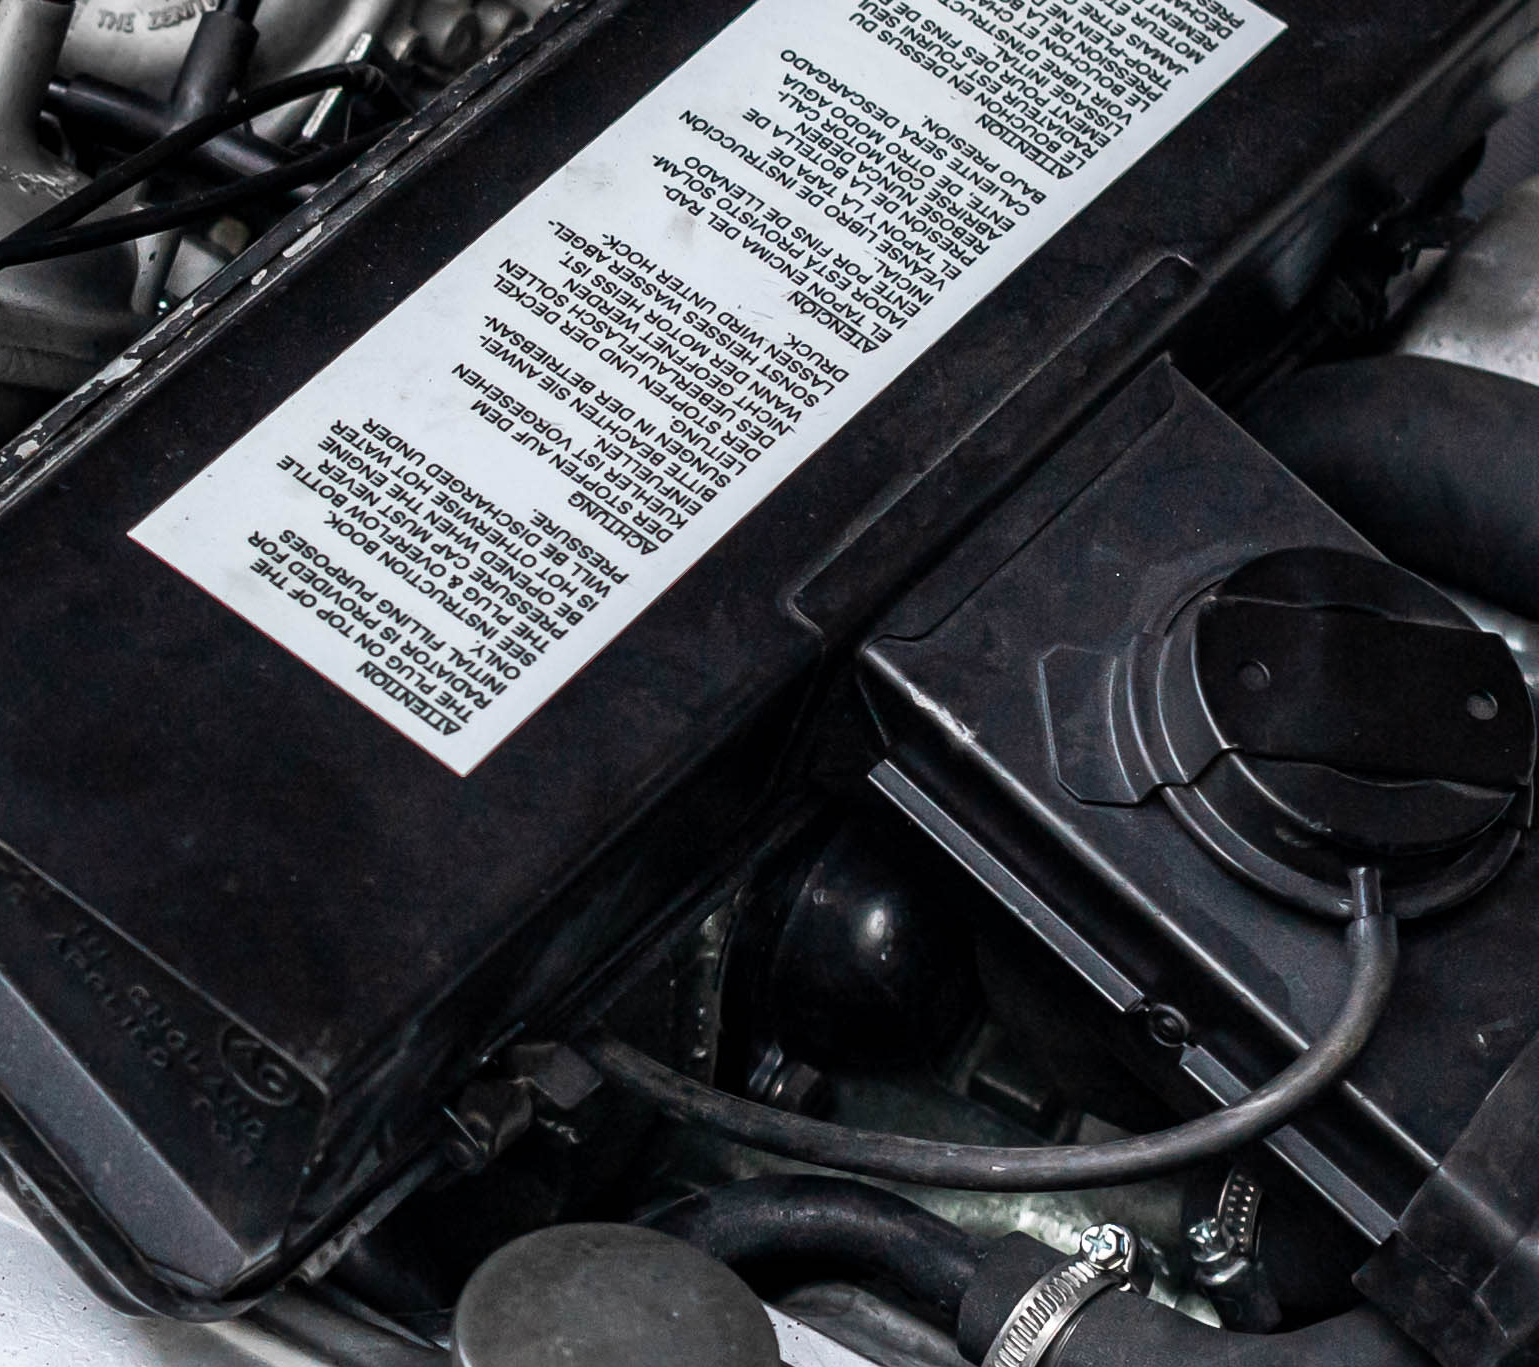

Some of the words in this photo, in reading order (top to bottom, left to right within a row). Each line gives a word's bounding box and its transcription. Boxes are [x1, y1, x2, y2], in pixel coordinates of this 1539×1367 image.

[1045, 3, 1074, 25] NE
[993, 42, 1050, 88] INITIAL.
[1039, 58, 1092, 96] LIBRE
[1072, 20, 1172, 92] TROP-PLEIN
[1049, 84, 1124, 137] LISSAGE
[1090, 92, 1132, 126] VOIR
[678, 109, 798, 190] INSTRUCCIÓN
[793, 121, 857, 165] DEBEN
[974, 113, 1074, 180] ATTENTION
[652, 154, 716, 200] SOLAM-
[795, 185, 825, 208] DE
[857, 160, 919, 207] NUNCA
[716, 197, 806, 260] PROVISTO
[823, 204, 878, 244] LIBRO
[916, 202, 991, 256] REBOSE
[498, 258, 569, 308] SOLLEN
[802, 254, 853, 291] ESTÁ
[874, 256, 935, 306] INICIAL.
[875, 239, 946, 292] VEÁNSE
[562, 277, 640, 335] WERDEN
[786, 290, 880, 354] ATENCIÓN
[850, 286, 908, 330] IADOR
[479, 335, 543, 379] ANWEI-
[483, 315, 597, 395] BETRIEBSAN-
[567, 303, 737, 423] UEBERLAUFFLASCH
[638, 331, 735, 397] GEOFFNET
[451, 363, 573, 452] VORGESEHEN
[537, 375, 572, 401] SIE
[594, 389, 636, 422] DER
[568, 397, 667, 467] BEACHTEN
[632, 417, 657, 437] IN
[732, 395, 792, 437] NICHT
[736, 419, 776, 450] DES
[317, 435, 389, 488] ENGINE
[330, 419, 393, 468] WATER
[362, 417, 426, 467] UNDER
[571, 448, 606, 472] IST
[653, 432, 732, 488] SUNGEN
[669, 415, 748, 476] LEITUNG.
[275, 454, 349, 508] BOTTLE
[317, 458, 382, 507] NEVER
[390, 465, 434, 496] HOT
[593, 434, 704, 517] EINFUELLEN.
[603, 466, 689, 530] KUEHLER
[663, 462, 718, 503] BITTE
[385, 483, 424, 515] THE
[425, 463, 543, 548] DISCHARGED
[323, 510, 381, 556] BOOK.
[344, 505, 447, 578] OVERFLOW
[377, 504, 433, 544] MUST
[423, 510, 480, 554] WHEN
[430, 491, 537, 568] OTHERWISE
[567, 490, 660, 556] ACHTUNG
[247, 530, 290, 564] FOR
[278, 529, 379, 603] PURPOSES
[430, 543, 470, 570] CAP
[529, 508, 630, 585] PRESSURE.
[539, 543, 570, 567] BE
[249, 558, 289, 591] THE
[288, 561, 382, 630] PROVIDED
[376, 550, 499, 640] INSTRUCTION
[447, 574, 464, 589] &
[480, 550, 555, 605] OPENED
[535, 567, 579, 598] HOT
[571, 562, 611, 599] WILL
[286, 589, 317, 608] OF
[462, 586, 514, 626] PLUG
[468, 566, 569, 641] PRESSURE
[553, 602, 584, 626] BE
[576, 594, 600, 612] IS
[315, 609, 355, 639] TOP
[353, 633, 385, 658] ON
[376, 599, 447, 652] FILLING
[379, 626, 402, 645] IS
[511, 622, 550, 654] THE
[448, 646, 508, 696] INITIAL
[469, 640, 521, 680] ONLY.
[496, 635, 537, 667] SEE
[355, 660, 462, 736] ATTENTION
[385, 655, 437, 695] PLUG
[400, 640, 493, 710] RADIATOR
[435, 691, 473, 724] THE
